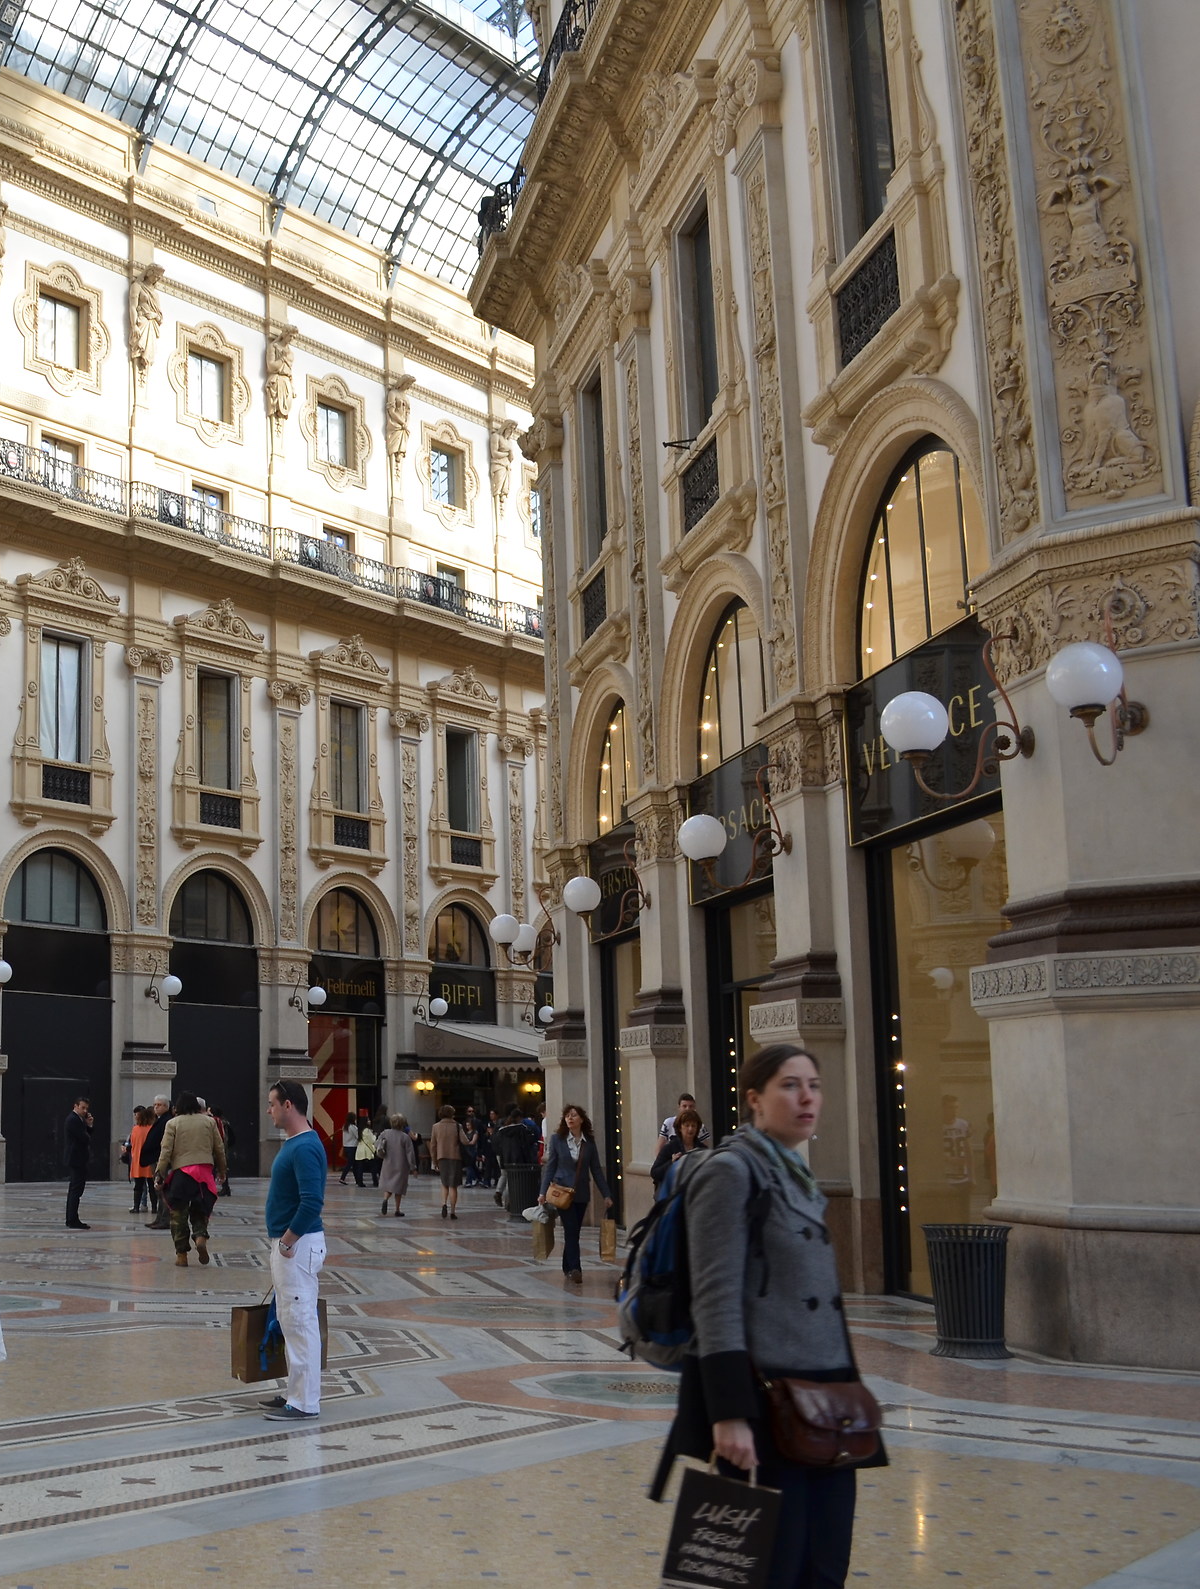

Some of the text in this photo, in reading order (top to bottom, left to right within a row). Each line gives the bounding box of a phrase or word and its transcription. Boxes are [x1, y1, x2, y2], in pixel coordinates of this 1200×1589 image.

[863, 684, 984, 776] VECE
[327, 978, 376, 996] Feltrinelli
[441, 983, 481, 1006] BIFFI
[692, 1502, 762, 1533] LUSH
